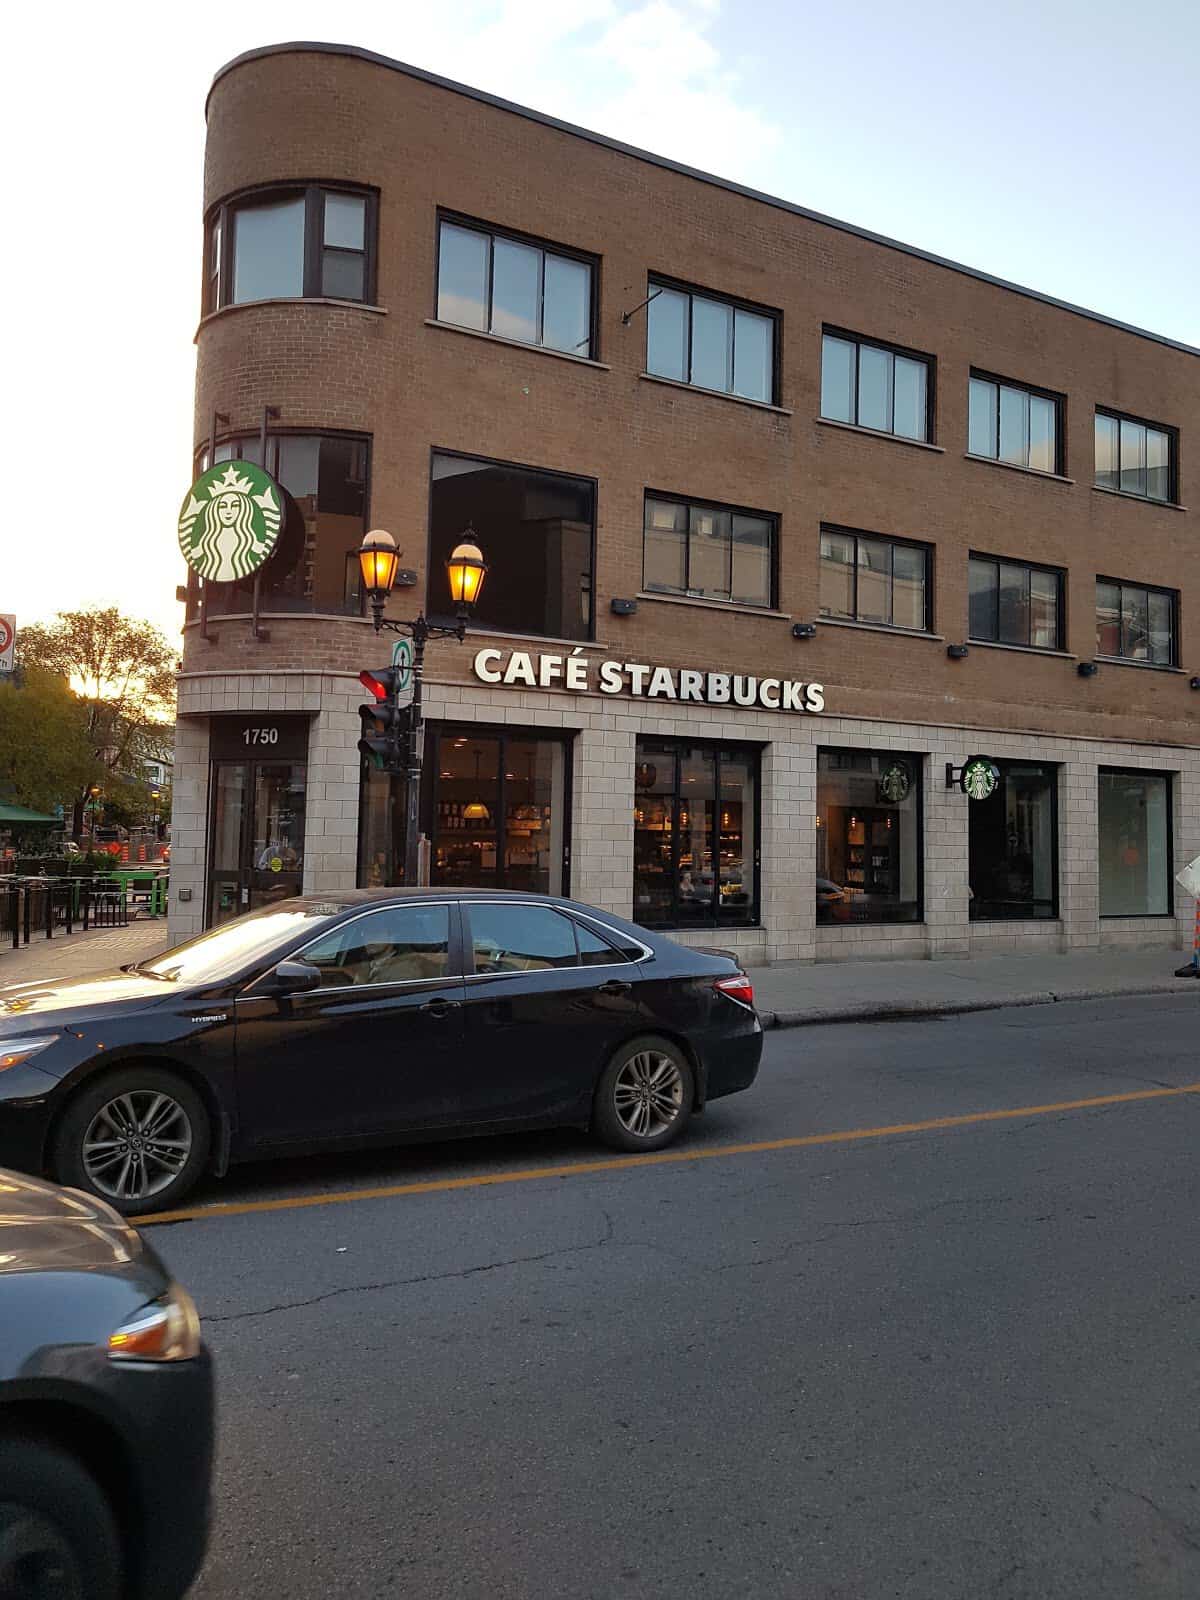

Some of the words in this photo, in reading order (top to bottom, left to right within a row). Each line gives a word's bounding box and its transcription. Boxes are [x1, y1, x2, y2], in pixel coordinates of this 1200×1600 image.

[473, 647, 588, 692] CAFÉ
[600, 661, 825, 712] STARBUCKS
[243, 728, 278, 745] 1750
